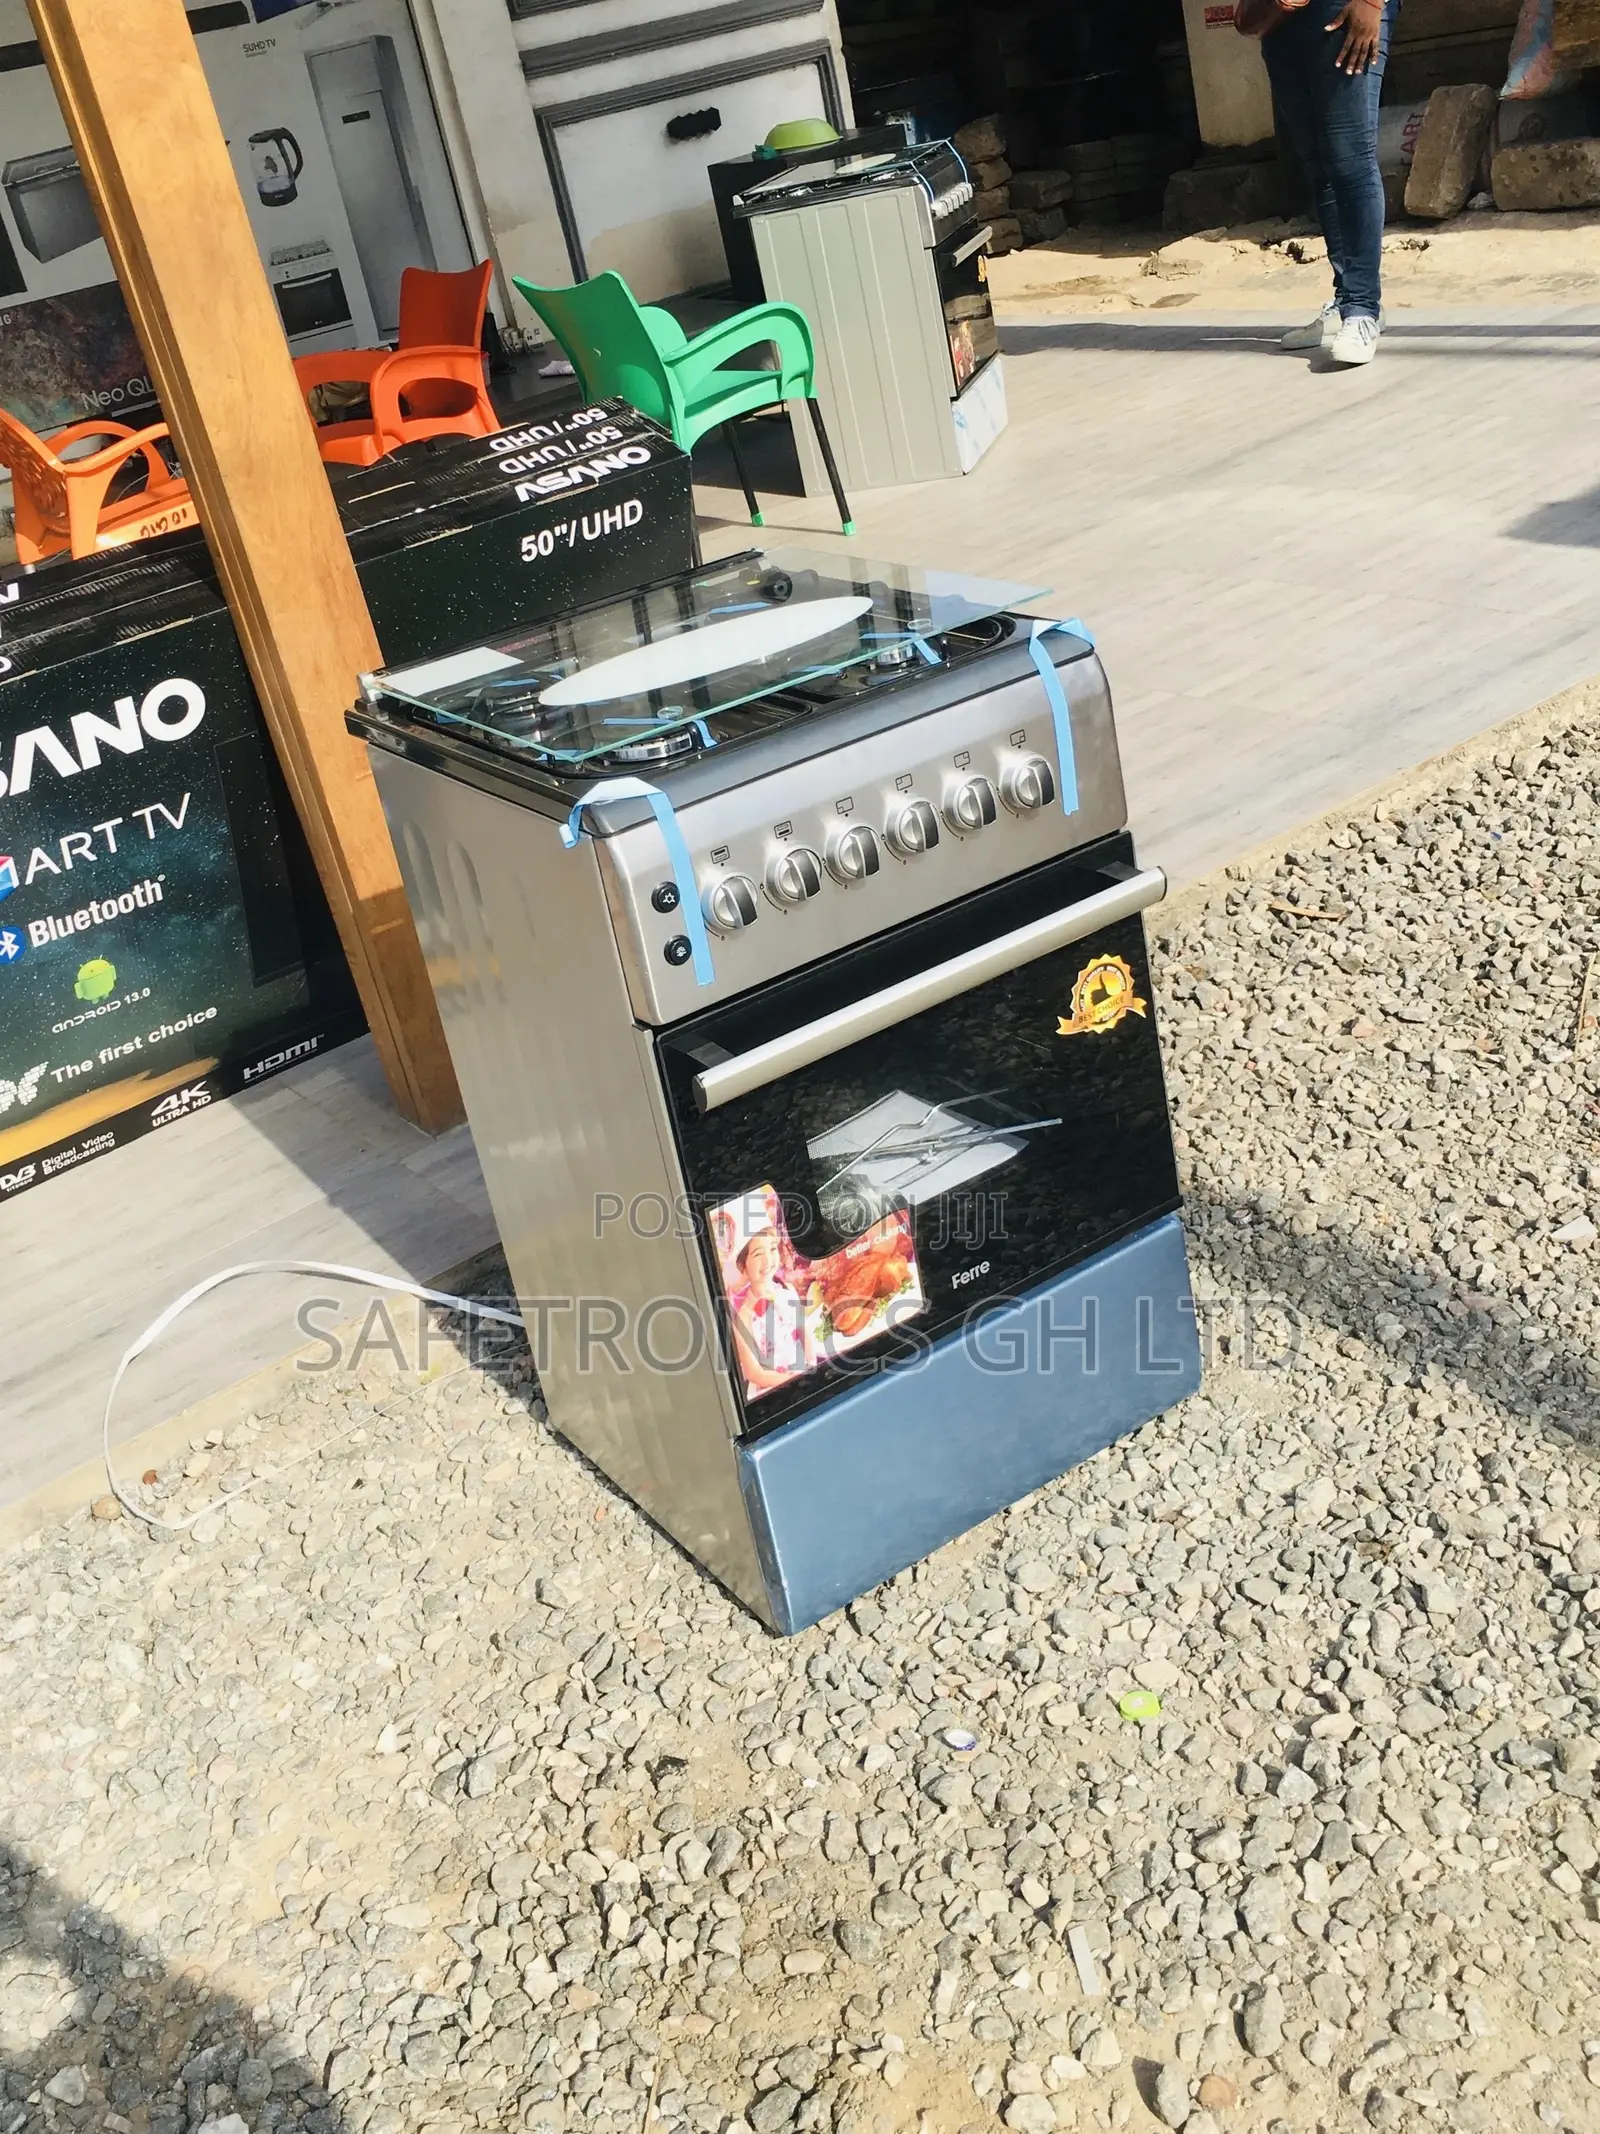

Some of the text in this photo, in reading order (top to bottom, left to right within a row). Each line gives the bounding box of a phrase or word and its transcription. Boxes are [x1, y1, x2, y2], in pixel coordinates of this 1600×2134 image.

[243, 38, 276, 53] SUHD TV
[80, 375, 156, 411] Neo QL
[514, 446, 652, 503] ASANO
[0, 677, 206, 797] ANO
[132, 792, 191, 840] TV
[28, 879, 163, 948] Bluetooth
[124, 987, 151, 1006] 13.0
[1078, 1011, 1096, 1024] BEST
[1097, 995, 1125, 1014] CHOICE
[50, 1006, 218, 1084] The first choice
[151, 1080, 210, 1117] 4K
[152, 1095, 212, 1127] ULTRA HD
[41, 1131, 114, 1168] Digital Video
[43, 1138, 116, 1175] Broadcasting
[0, 1163, 36, 1190] DVB
[845, 1241, 871, 1259] better
[951, 1260, 990, 1290] Ferre
